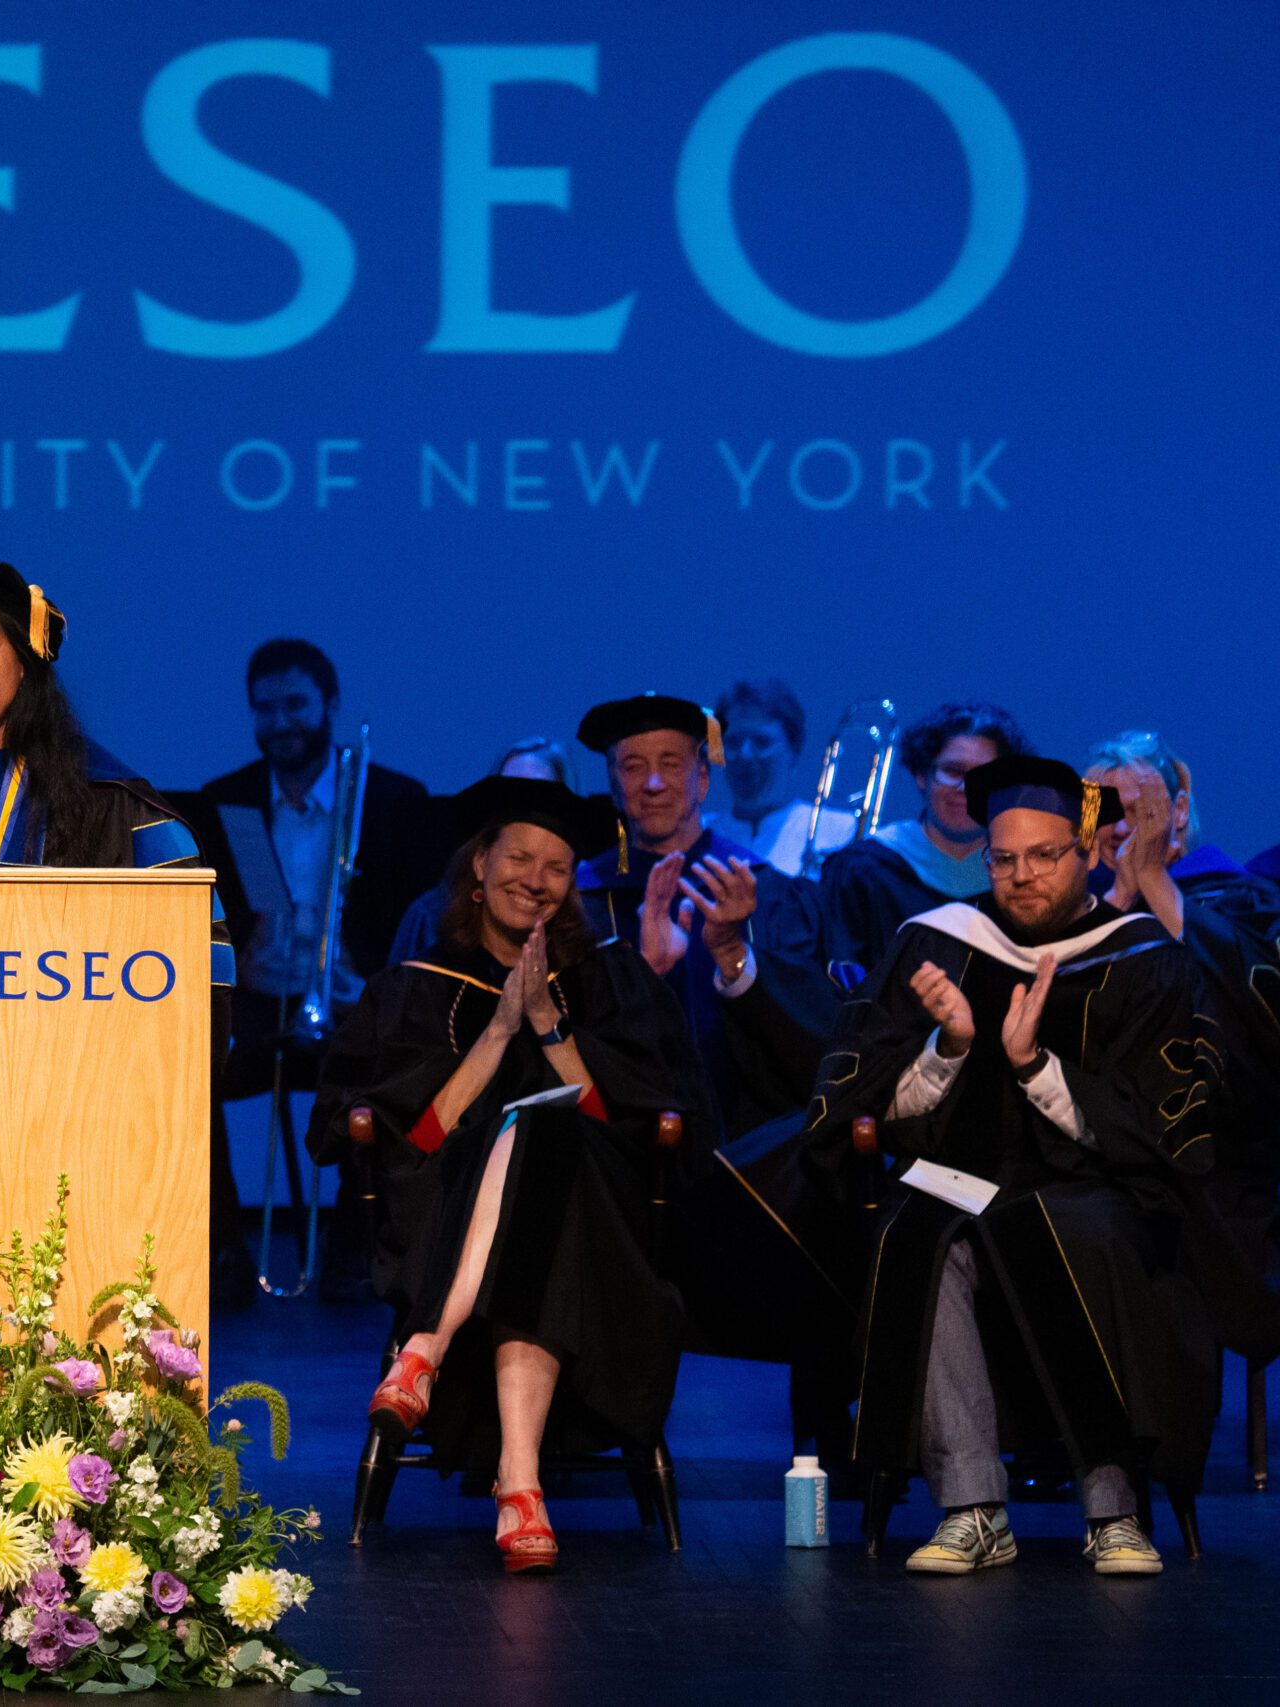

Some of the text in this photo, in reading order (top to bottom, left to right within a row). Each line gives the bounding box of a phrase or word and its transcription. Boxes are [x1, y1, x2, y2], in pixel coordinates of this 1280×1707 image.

[221, 438, 361, 512] OF
[420, 438, 659, 512] NEW
[717, 438, 1010, 511] YORK
[815, 1485, 825, 1535] WATER
